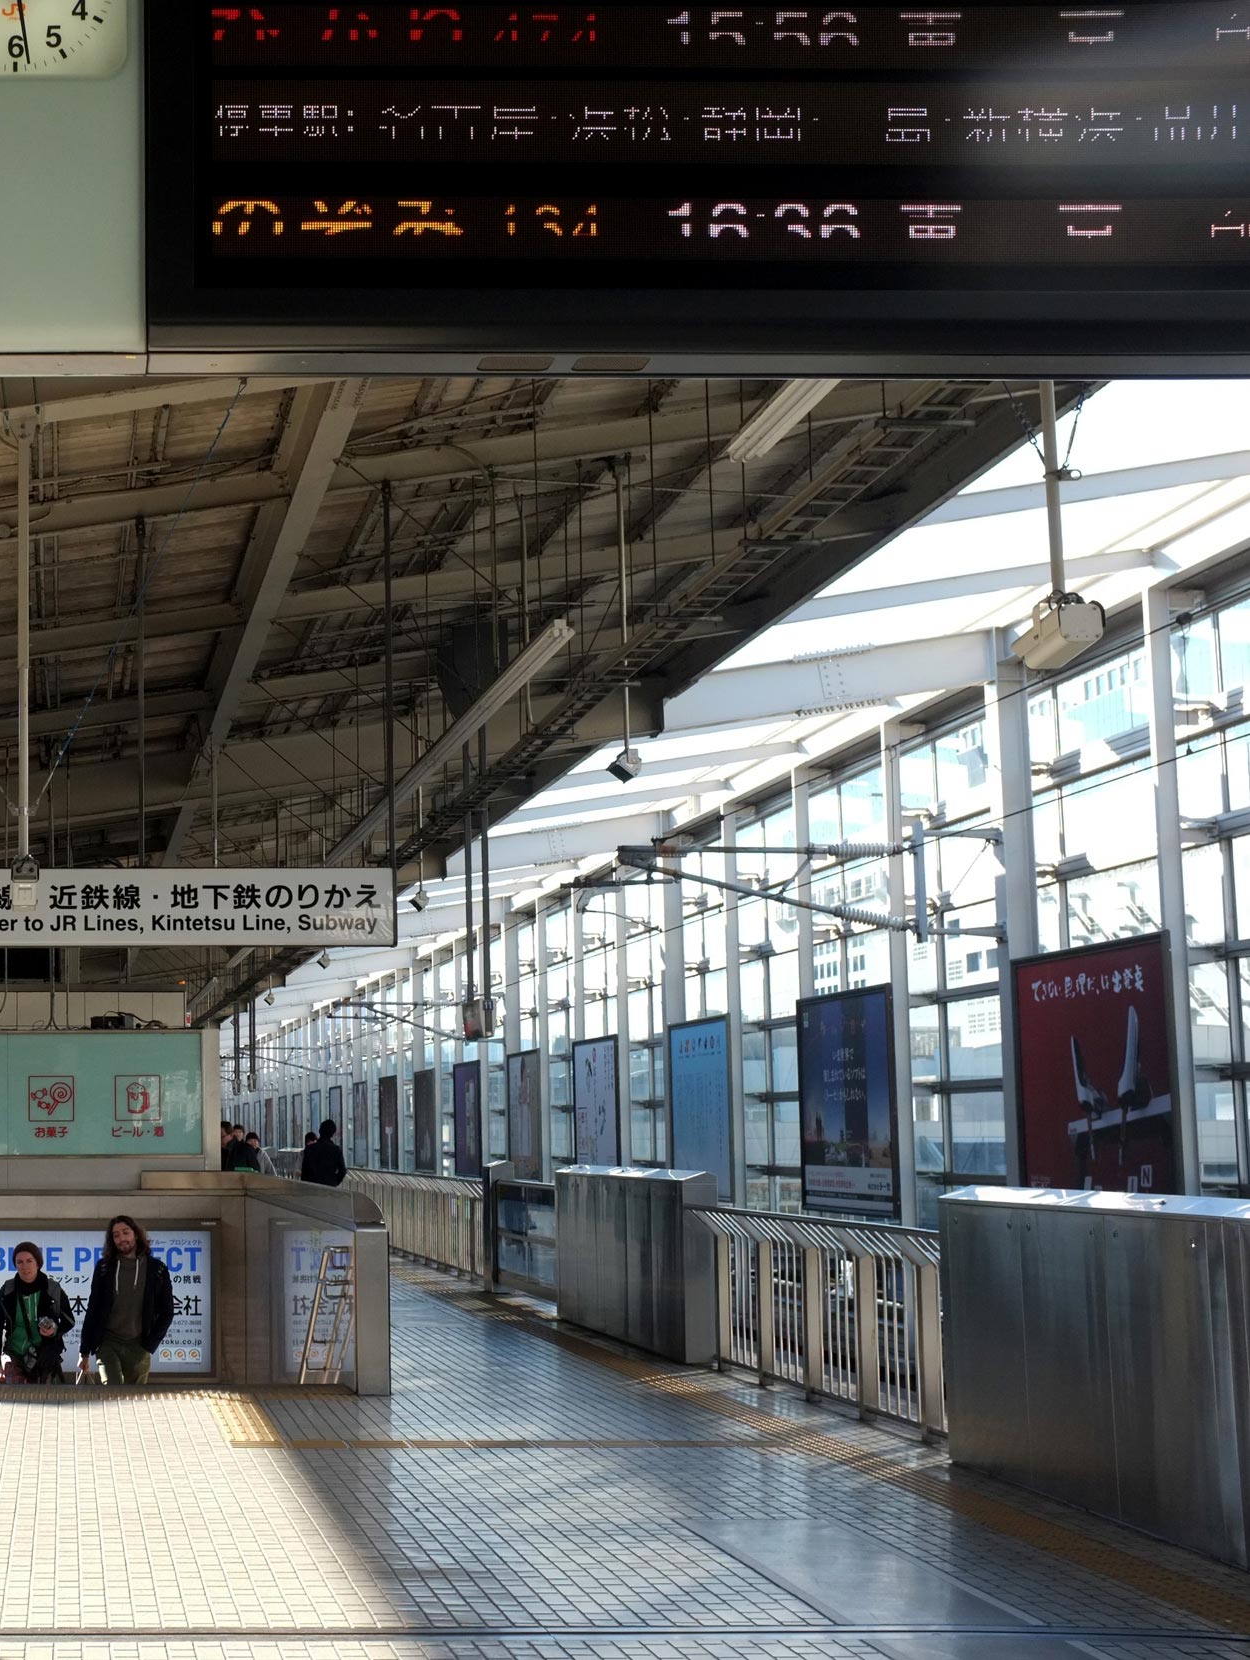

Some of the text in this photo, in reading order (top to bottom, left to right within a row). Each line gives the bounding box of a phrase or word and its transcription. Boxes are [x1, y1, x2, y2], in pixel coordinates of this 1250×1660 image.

[72, 0, 88, 20] 4
[8, 35, 24, 58] 6
[46, 25, 62, 48] 5
[24, 916, 44, 931] to
[50, 915, 76, 931] JR
[84, 915, 144, 934] Lines,
[151, 914, 235, 931] Kintetsu
[243, 914, 291, 934] Line,
[298, 914, 377, 934] Subway
[34, 1126, 68, 1138] お菓子
